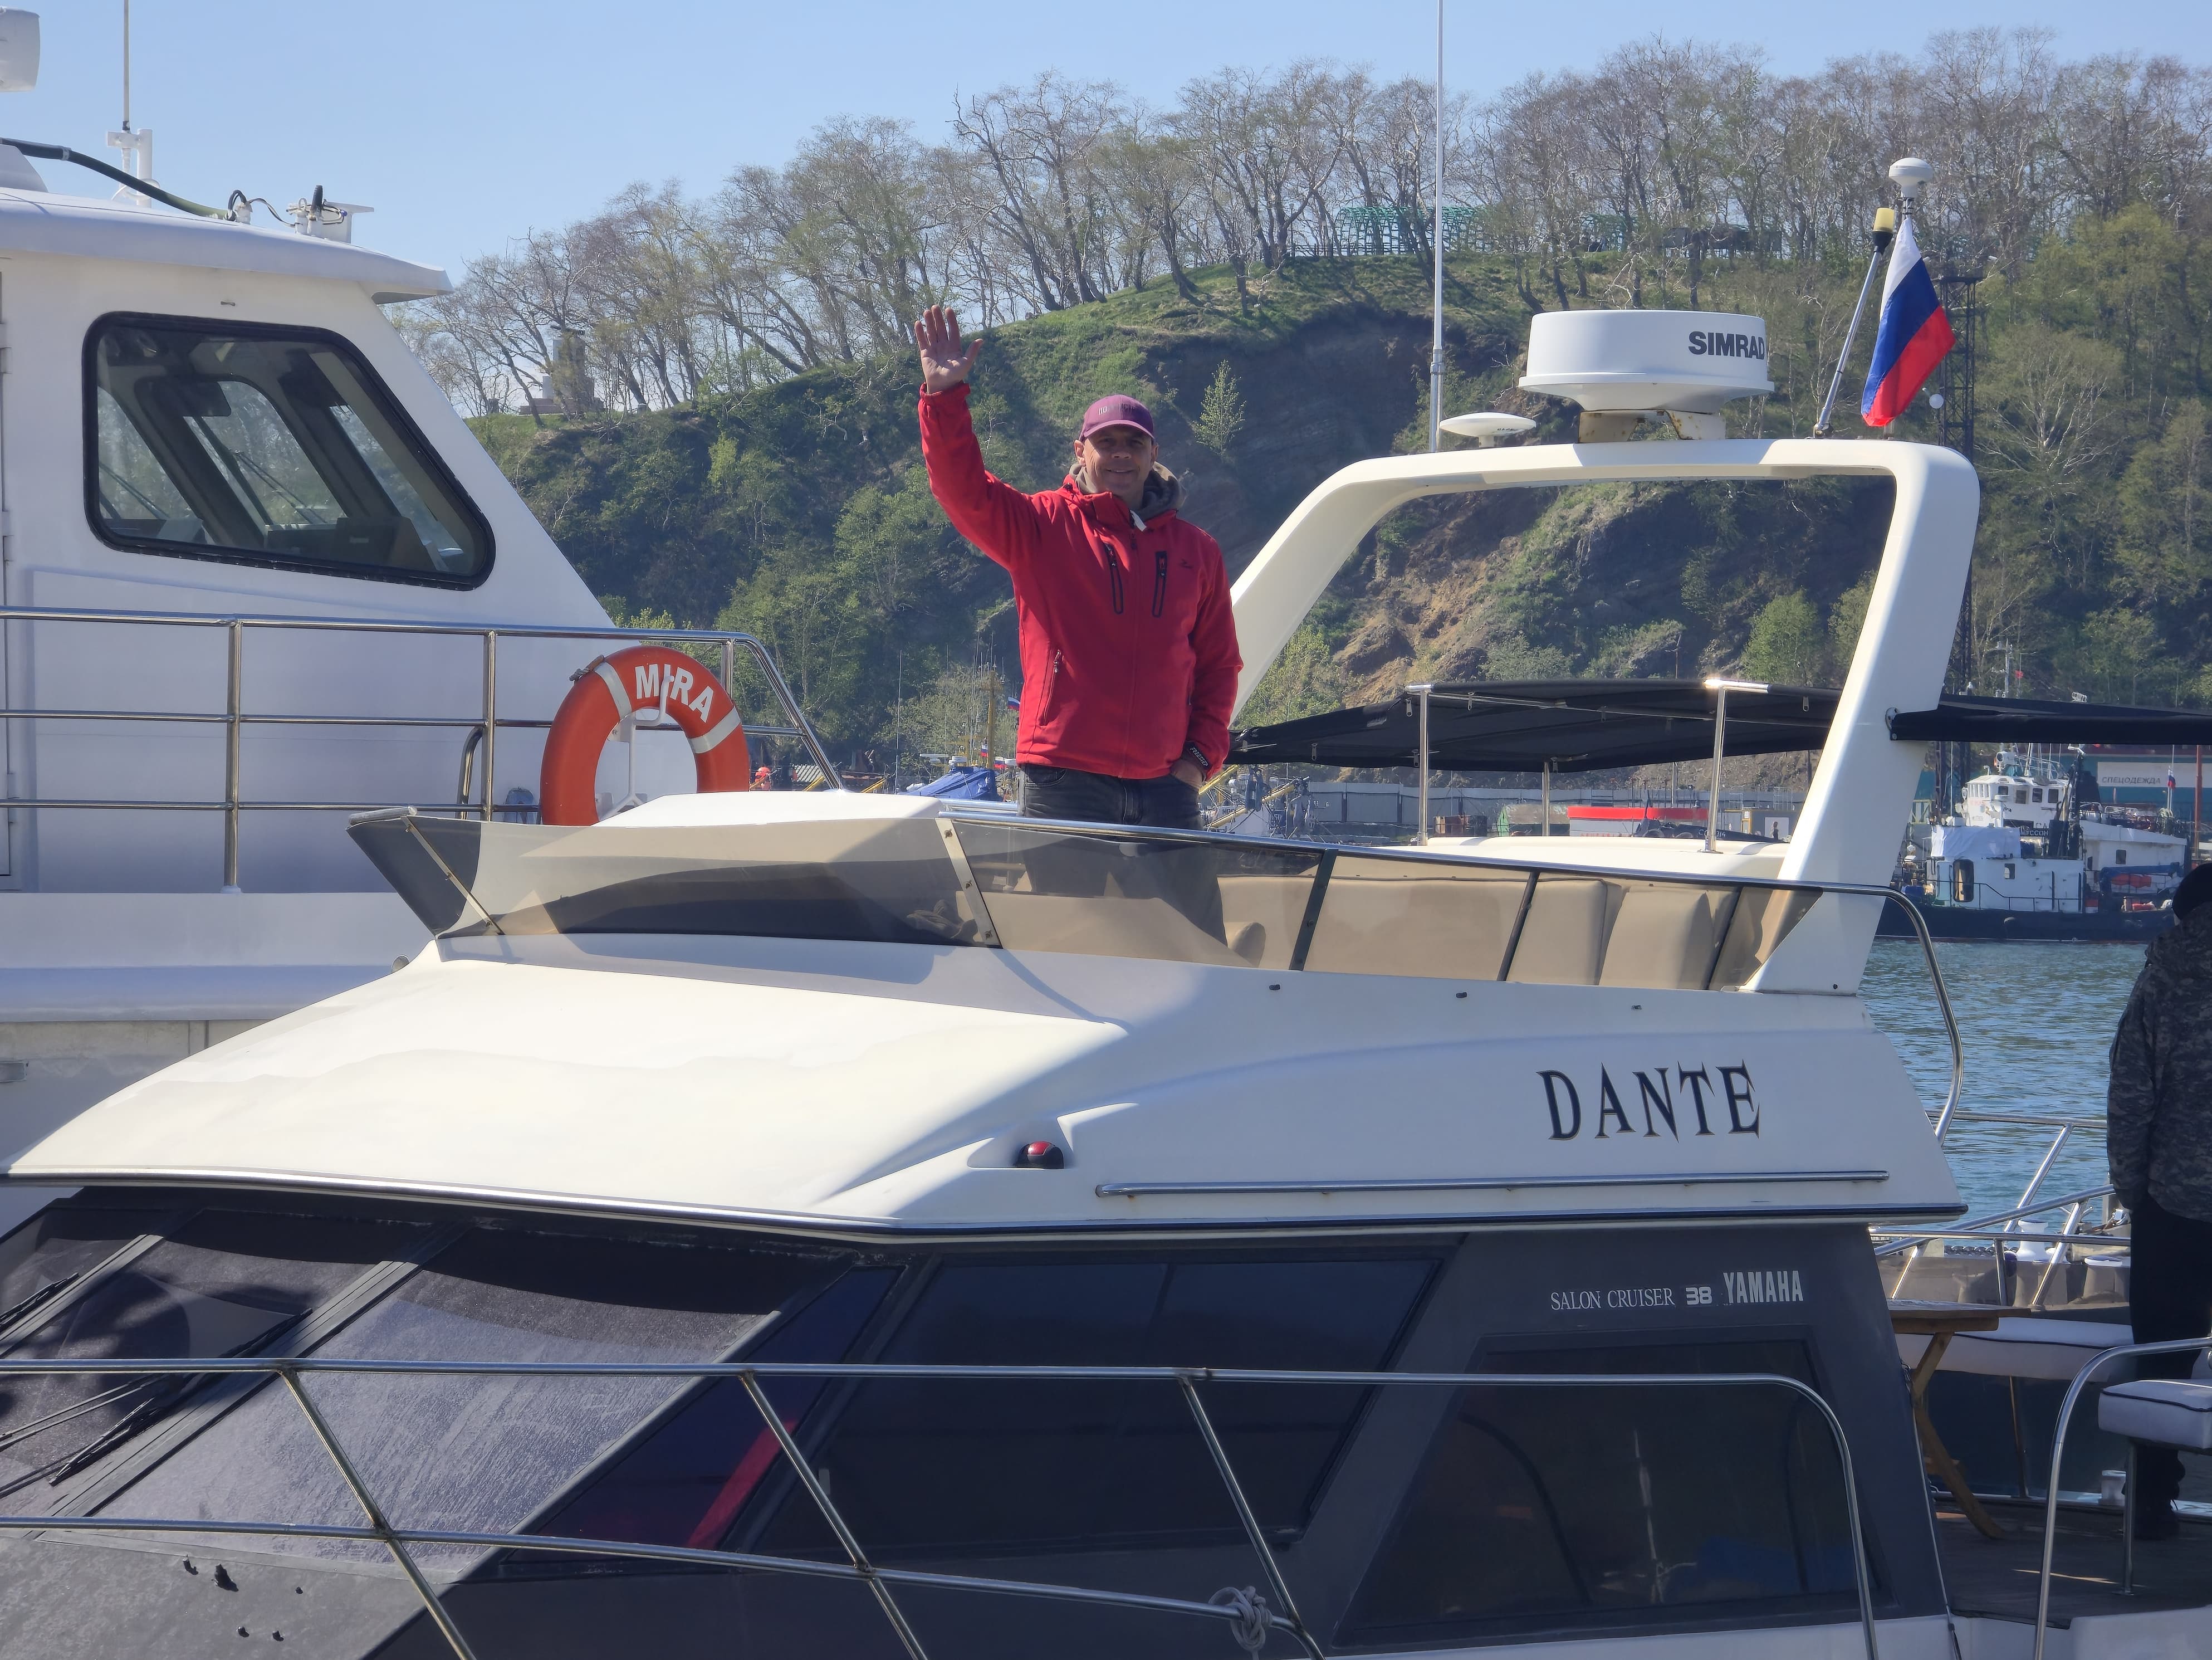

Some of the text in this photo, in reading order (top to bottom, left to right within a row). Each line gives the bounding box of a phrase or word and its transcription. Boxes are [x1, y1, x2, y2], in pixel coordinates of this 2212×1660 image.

[1688, 331, 1765, 360] SIMRAD
[1536, 1059, 1760, 1143] DANTE
[1550, 1270, 1804, 1310] SALON CRUISER 38 YAMAHA
